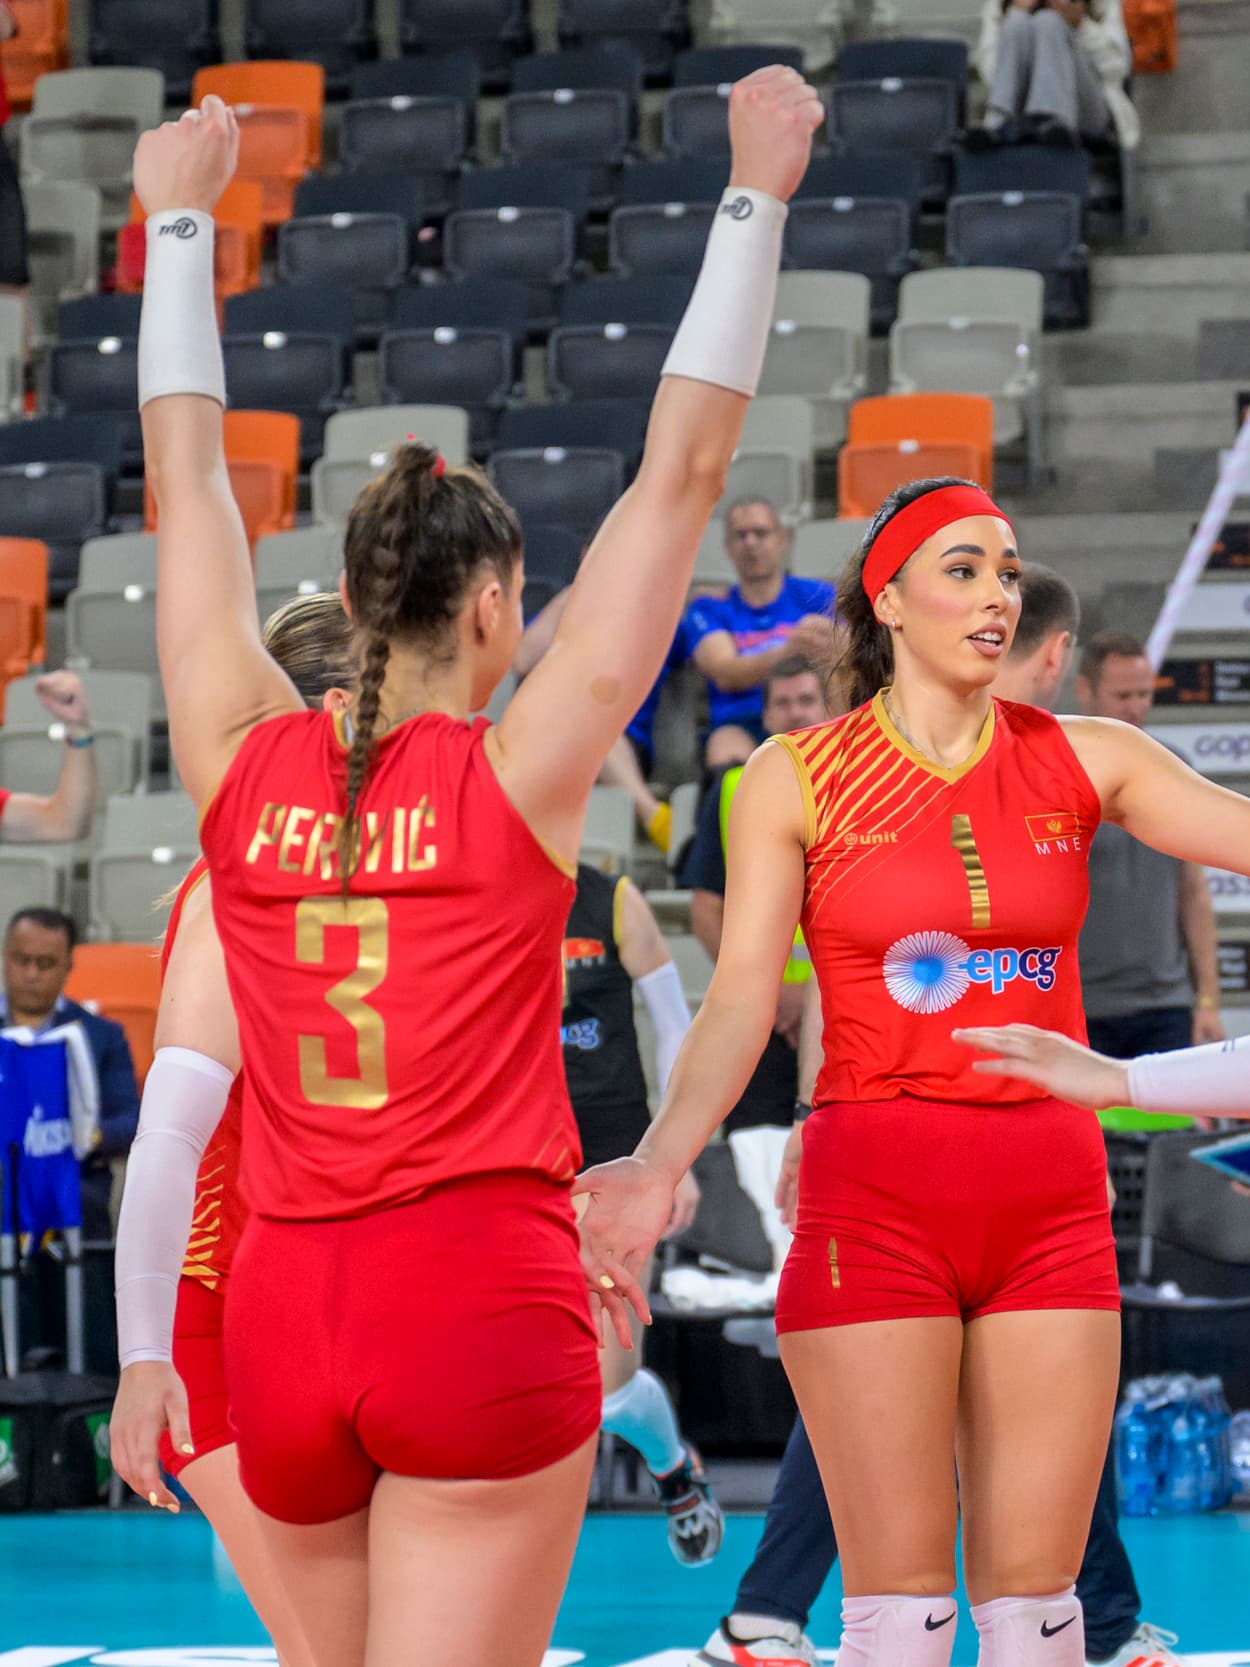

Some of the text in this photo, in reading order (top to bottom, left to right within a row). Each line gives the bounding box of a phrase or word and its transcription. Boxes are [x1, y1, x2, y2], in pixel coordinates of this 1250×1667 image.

[952, 814, 991, 929] 1
[295, 895, 388, 1110] 3
[960, 945, 1063, 995] epcg
